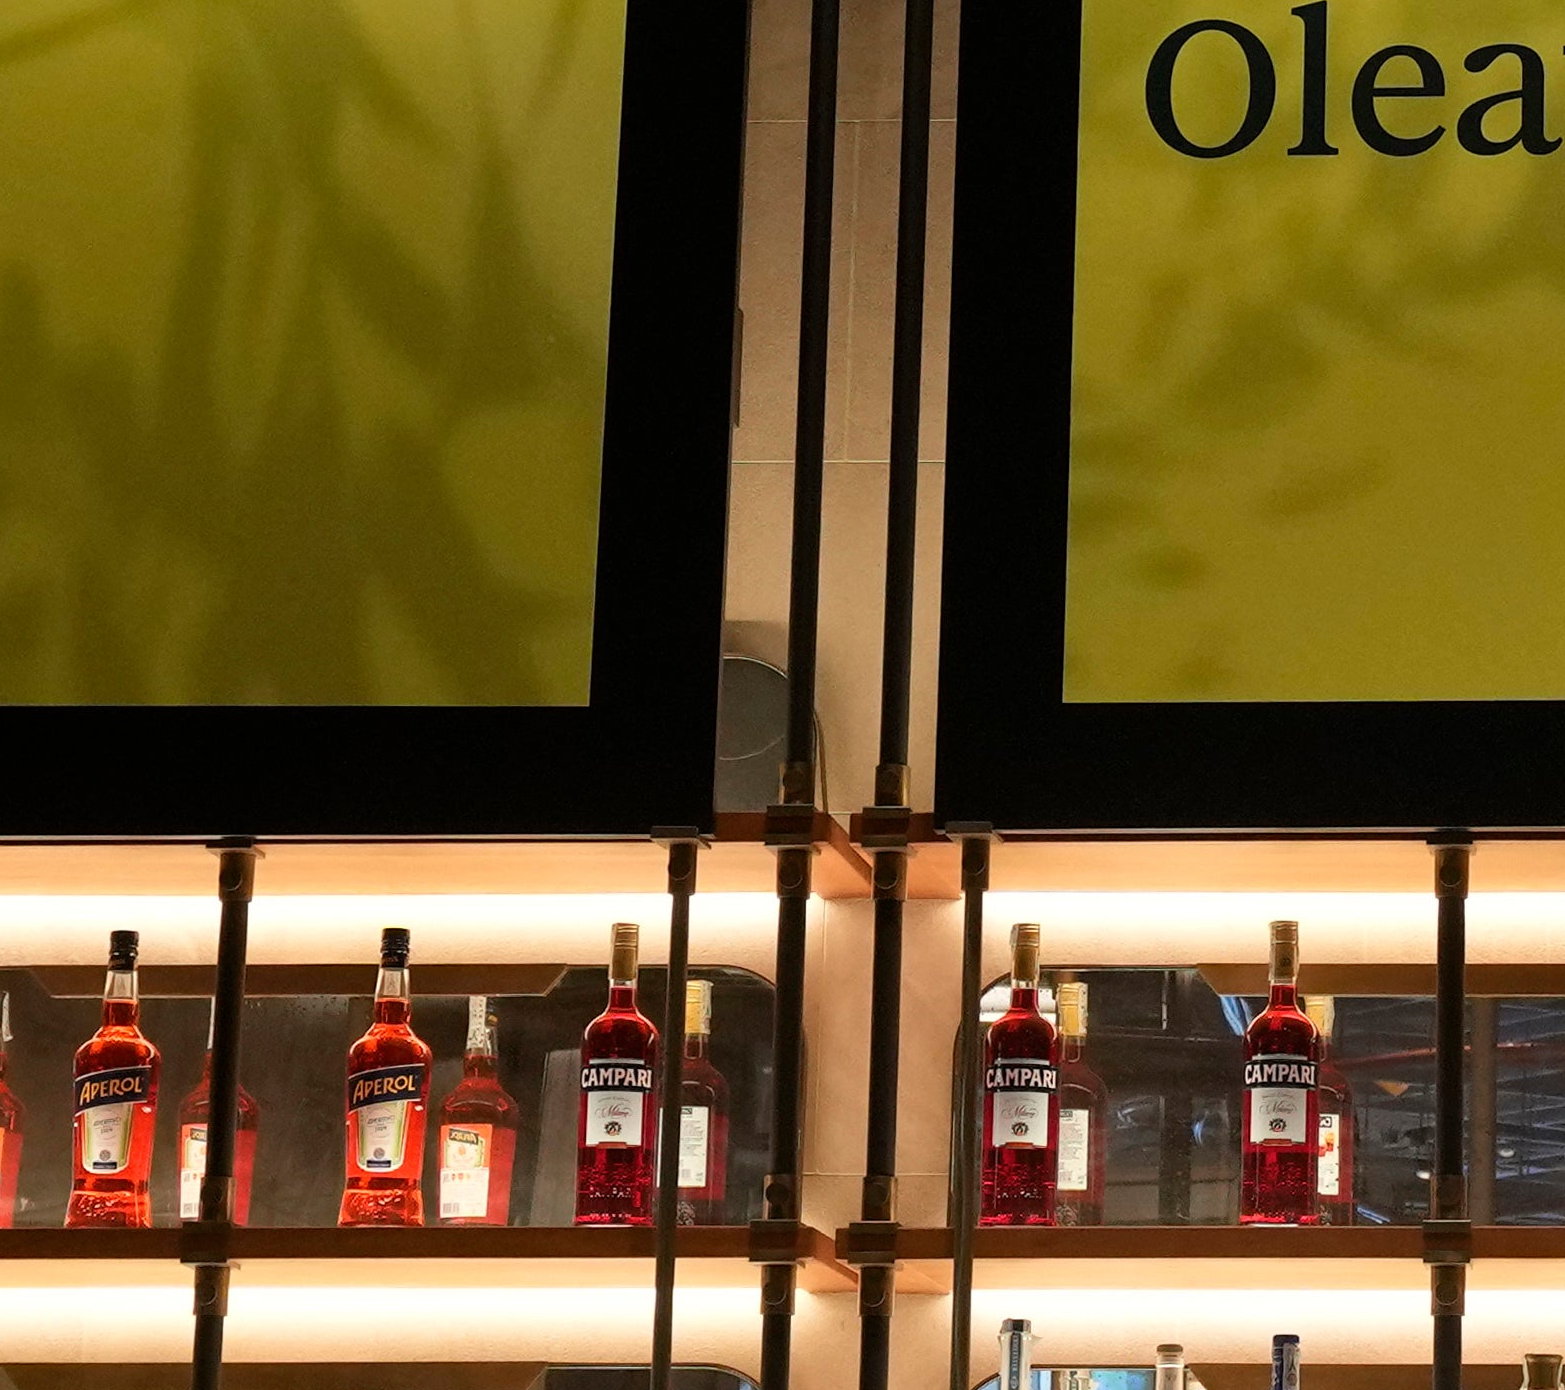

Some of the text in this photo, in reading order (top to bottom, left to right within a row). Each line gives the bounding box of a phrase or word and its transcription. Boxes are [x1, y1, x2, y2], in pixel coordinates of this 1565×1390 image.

[580, 1066, 653, 1090] CAMPARI
[985, 1066, 1059, 1091] CAMPARI
[1243, 1062, 1318, 1087] CAMPARI
[79, 1076, 143, 1107] APEROL
[353, 1074, 416, 1105] APEROL
